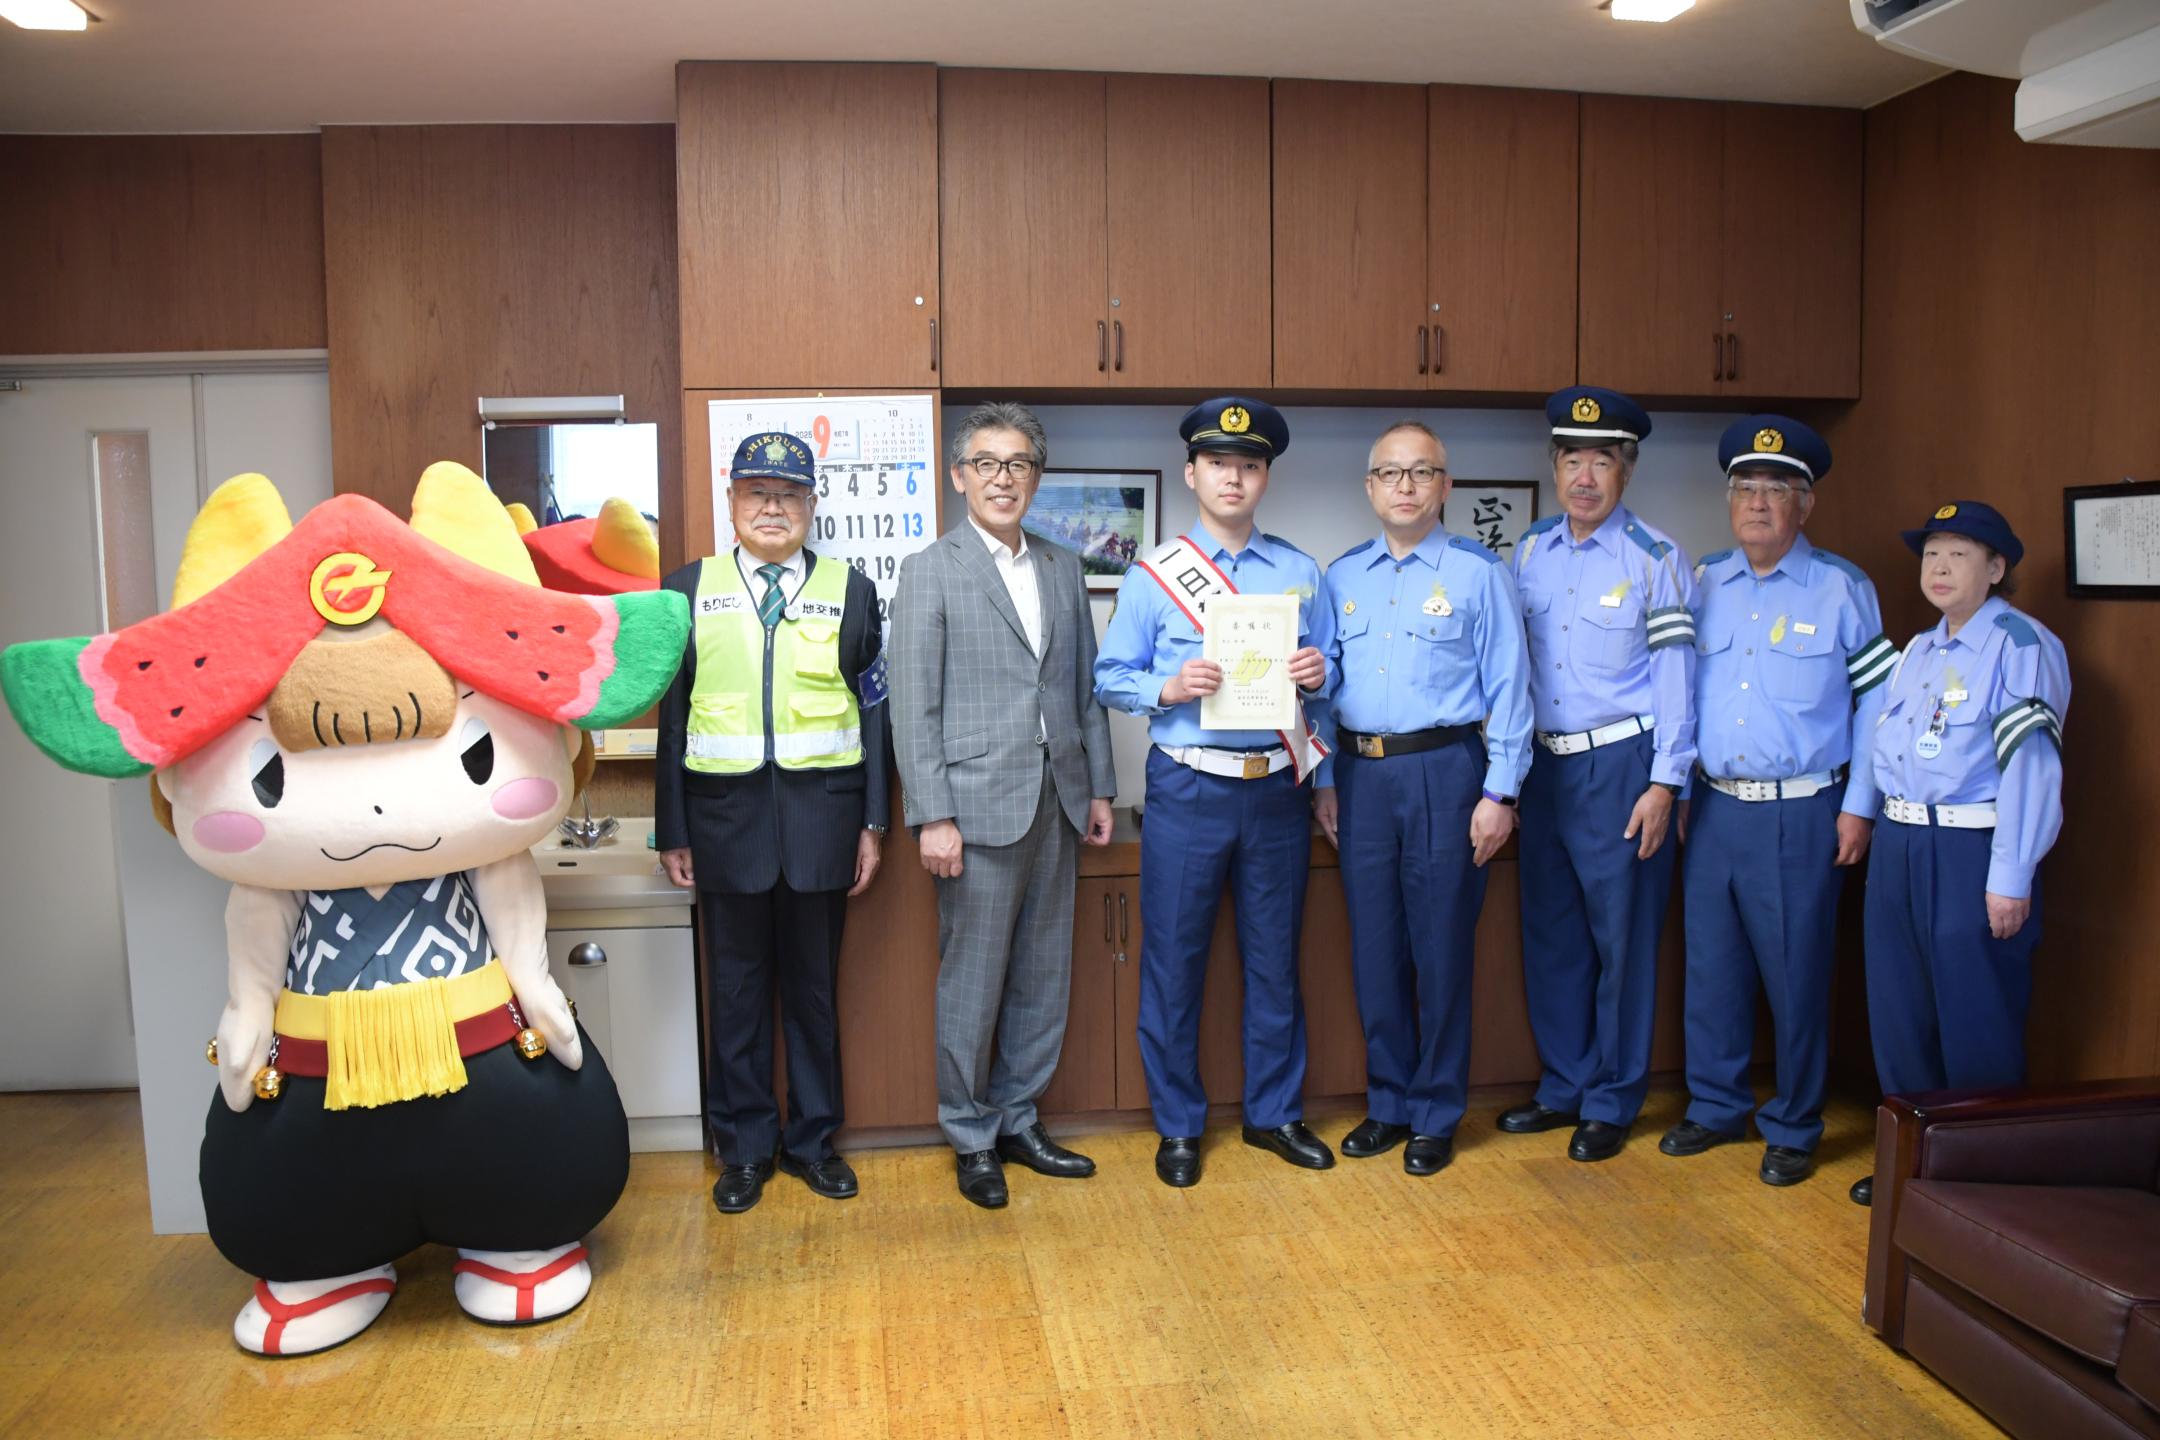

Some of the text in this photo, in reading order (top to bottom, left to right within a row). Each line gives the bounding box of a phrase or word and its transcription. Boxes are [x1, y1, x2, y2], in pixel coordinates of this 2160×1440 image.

[813, 415, 830, 459] 9
[819, 471, 917, 498] 3 4 5 6
[815, 513, 923, 540] 10 11 12 13
[876, 556, 895, 580] 19
[1159, 548, 1221, 613] 一日
[702, 597, 741, 612] もりにし
[803, 602, 842, 618] 地交推
